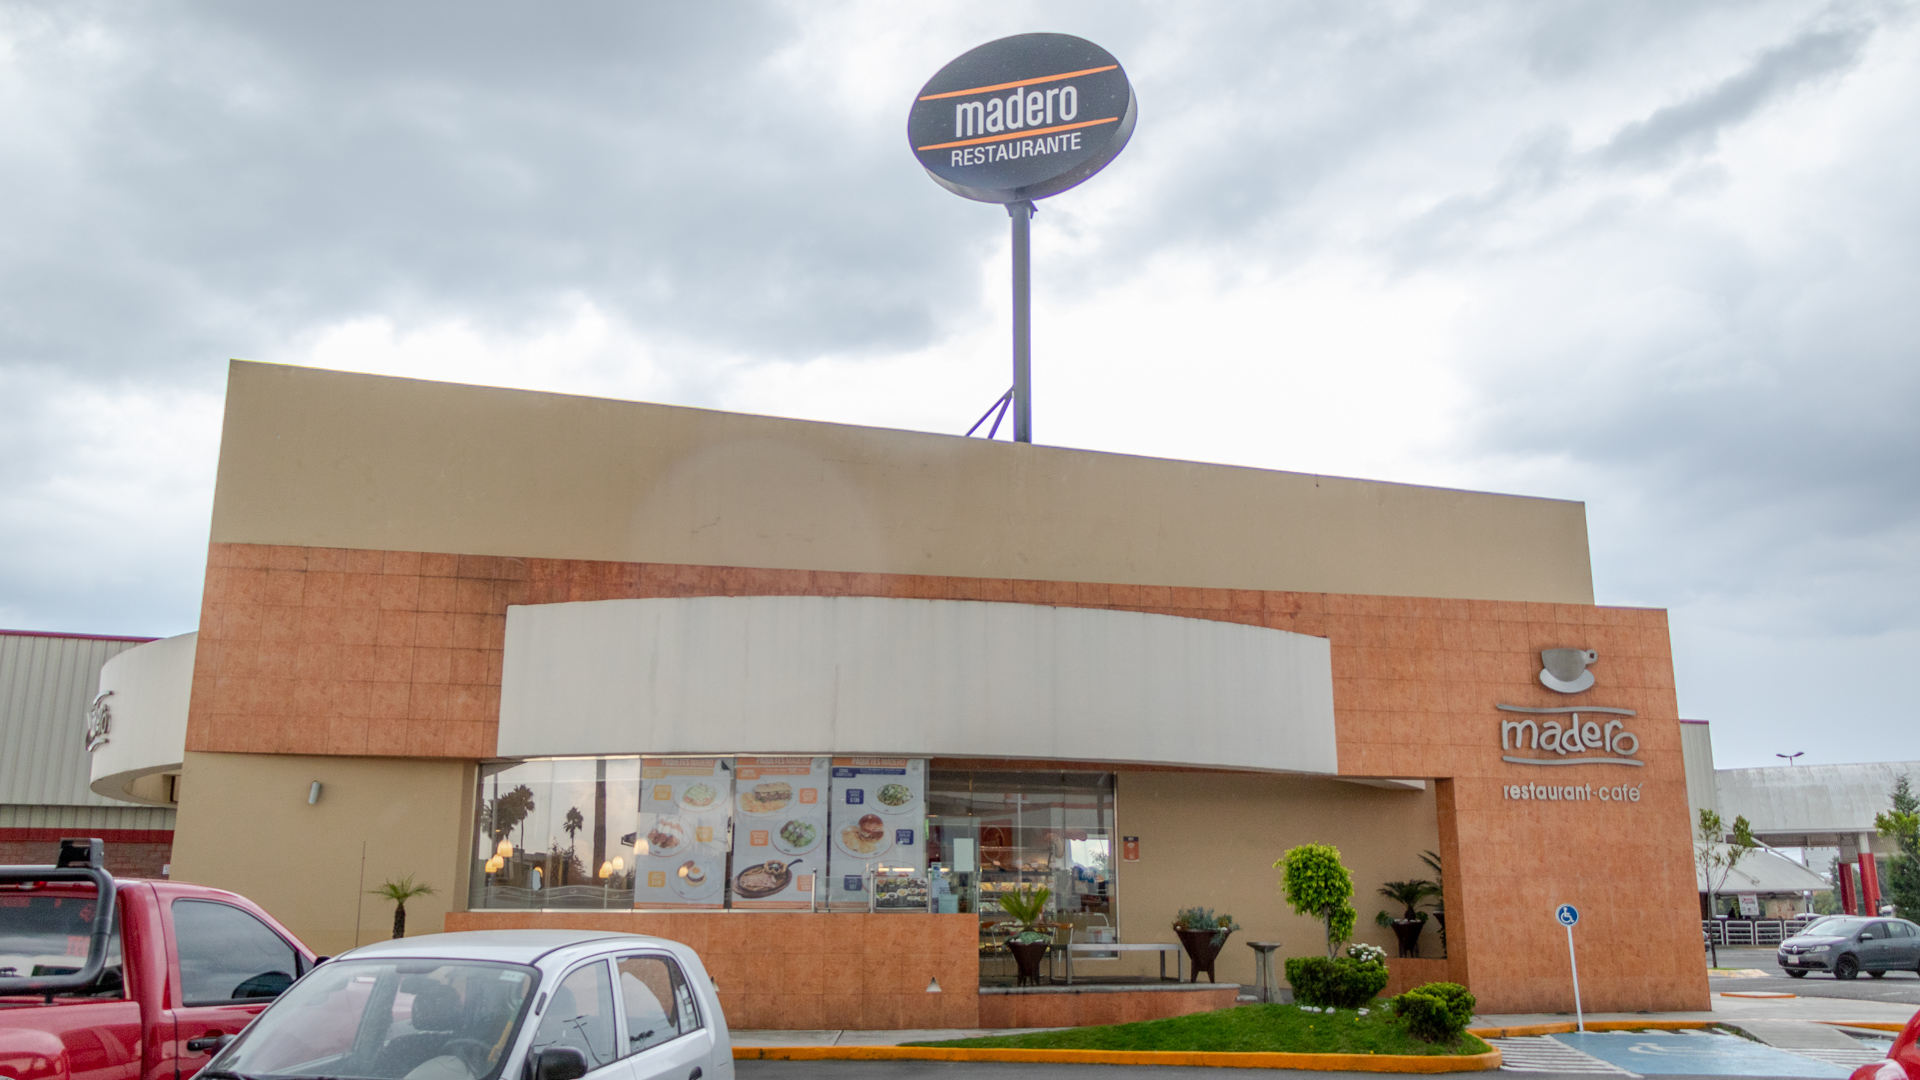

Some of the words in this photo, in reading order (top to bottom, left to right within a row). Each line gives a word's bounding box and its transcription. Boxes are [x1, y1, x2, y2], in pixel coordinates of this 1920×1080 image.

[955, 86, 1078, 138] madero
[951, 132, 1082, 167] RESTAURANTE
[1502, 713, 1639, 755] madero
[755, 757, 785, 765] PAQUETES
[852, 757, 881, 766] PAQUETES
[882, 758, 906, 766] MADERO
